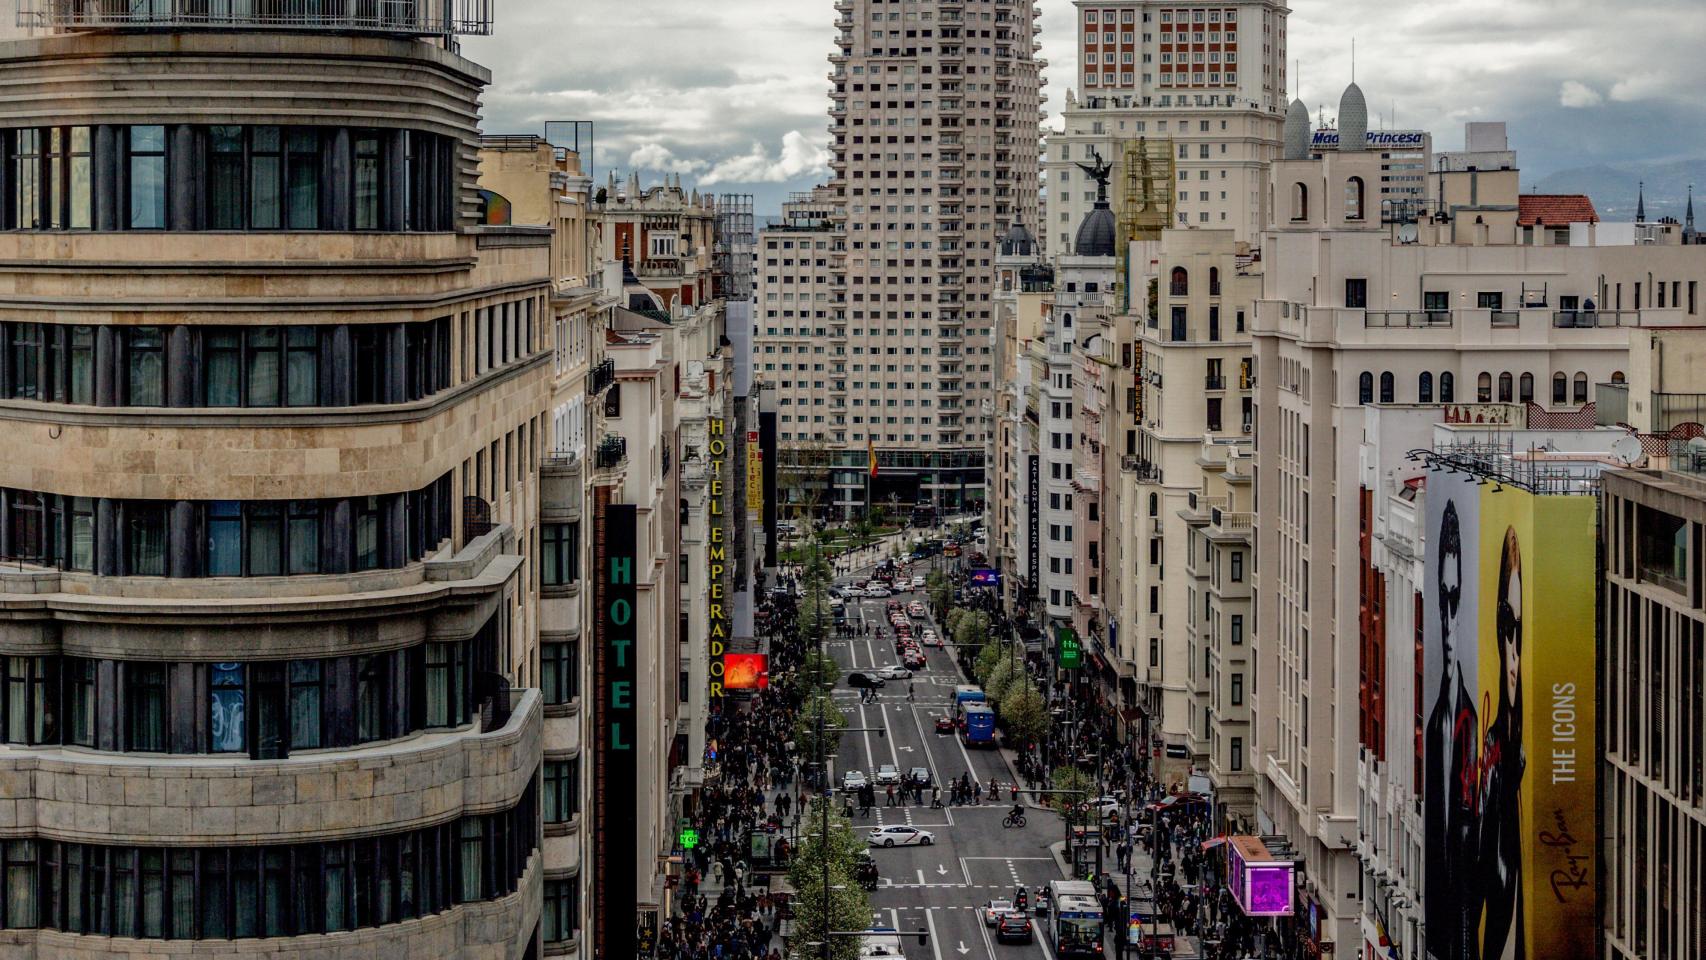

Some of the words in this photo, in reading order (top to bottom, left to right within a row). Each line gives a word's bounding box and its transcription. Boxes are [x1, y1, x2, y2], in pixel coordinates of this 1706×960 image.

[1366, 132, 1422, 144] Princesa
[710, 419, 725, 515] HOTEL
[610, 556, 632, 750] HOTEL
[710, 527, 725, 698] EMPERADOR
[1552, 682, 1576, 742] ICONS
[1552, 748, 1576, 785] THE
[1538, 807, 1590, 904] Ray-Ban
